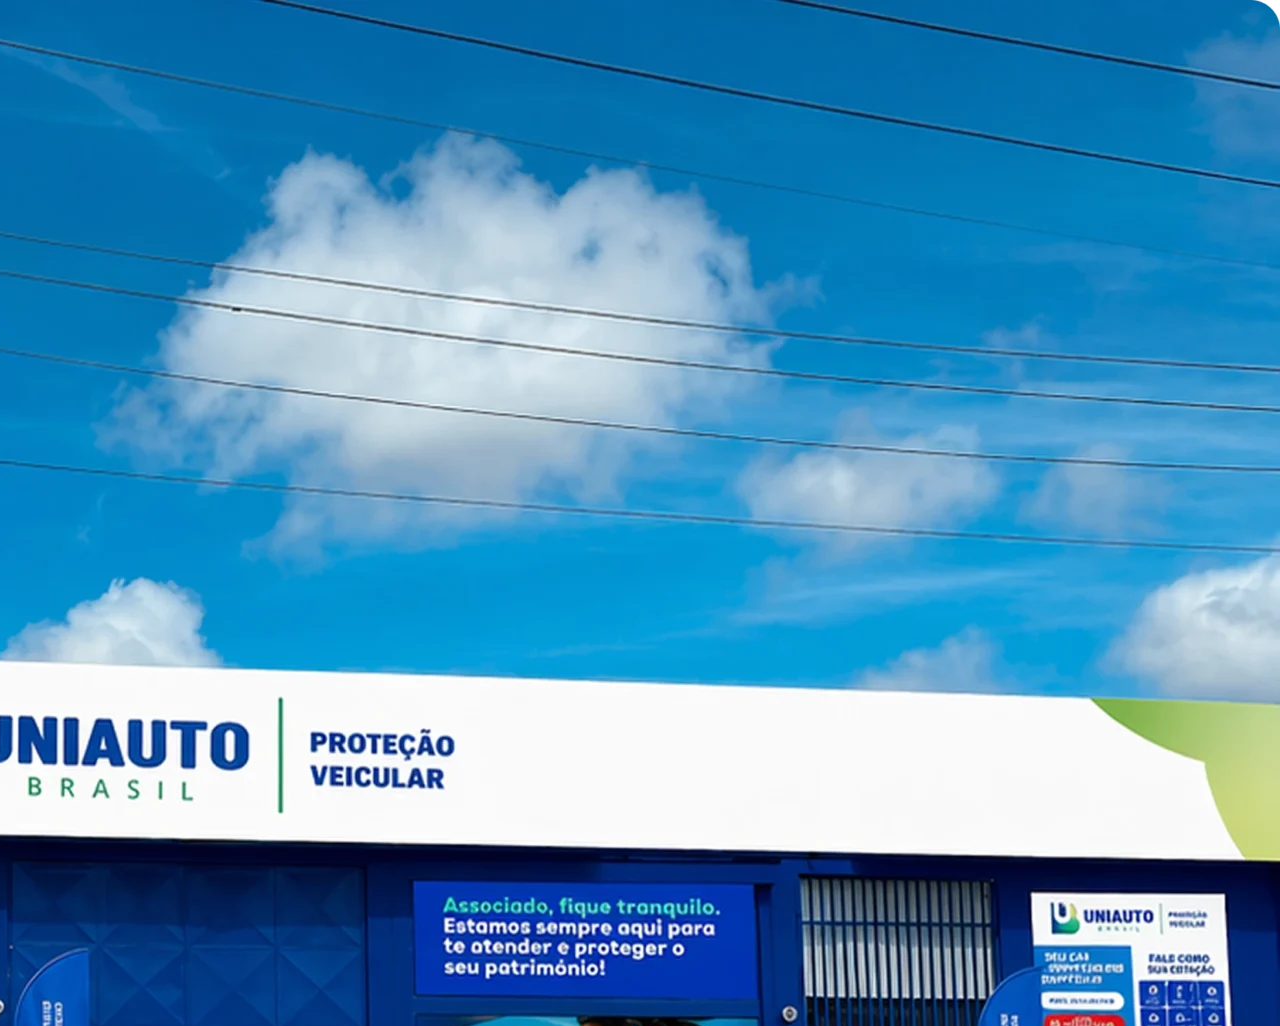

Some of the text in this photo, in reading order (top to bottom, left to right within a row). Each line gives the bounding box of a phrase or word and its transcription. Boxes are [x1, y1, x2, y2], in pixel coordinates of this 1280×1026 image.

[311, 729, 454, 761] PROTEÇÃO
[310, 765, 444, 789] VEICULAR
[28, 777, 193, 801] BRASIL
[443, 897, 720, 919] Associado, fique tranquilo.
[1084, 910, 1154, 923] UNIAUTO
[444, 918, 715, 939] Estamos sempre aqui para
[444, 938, 684, 960] te atender e proteger o
[445, 962, 479, 974] seu
